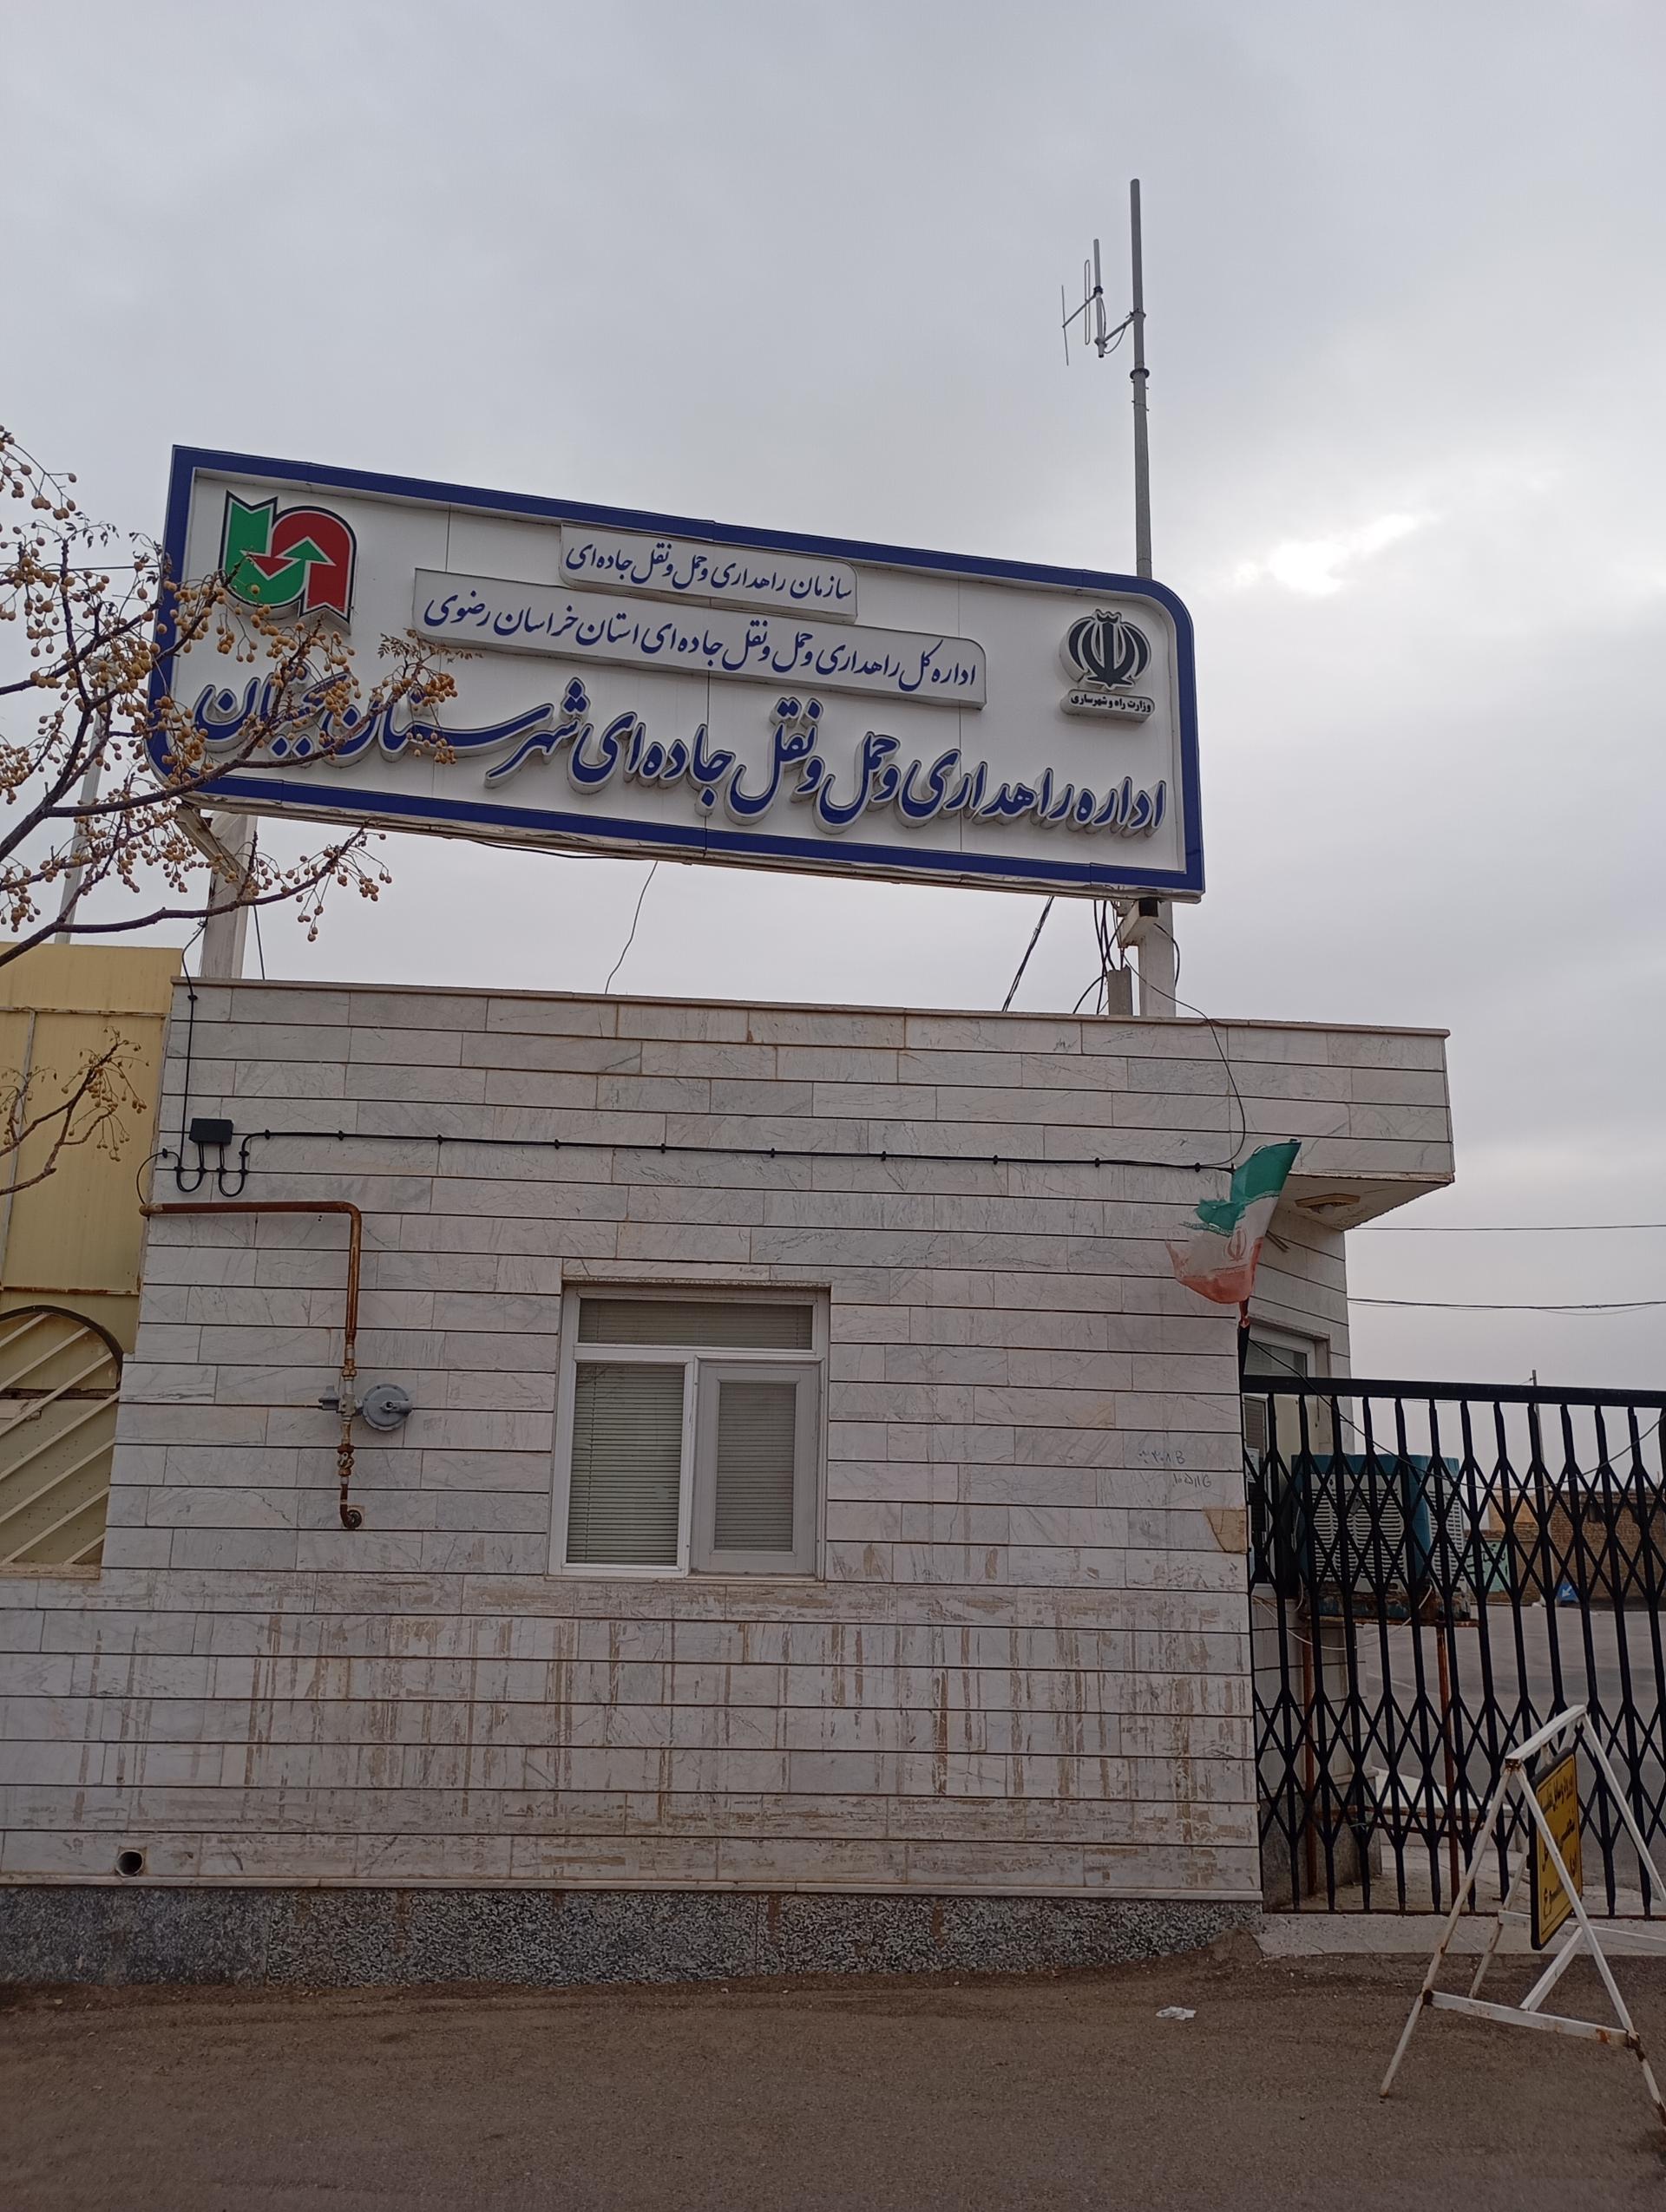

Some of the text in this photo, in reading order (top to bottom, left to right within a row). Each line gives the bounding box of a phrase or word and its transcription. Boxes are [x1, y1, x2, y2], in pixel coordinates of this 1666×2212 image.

[711, 562, 786, 592] راهداری
[790, 574, 852, 599] سازمان
[423, 590, 491, 626] رضوی
[493, 604, 579, 636] خراسان
[574, 612, 640, 646] استان
[815, 644, 901, 676] راهداری
[898, 638, 944, 692] کل
[931, 663, 976, 685] اداره
[1114, 697, 1126, 710] راه
[1126, 700, 1152, 713] وزارت
[900, 748, 1074, 820] راهداری
[1074, 776, 1166, 829] اداره
